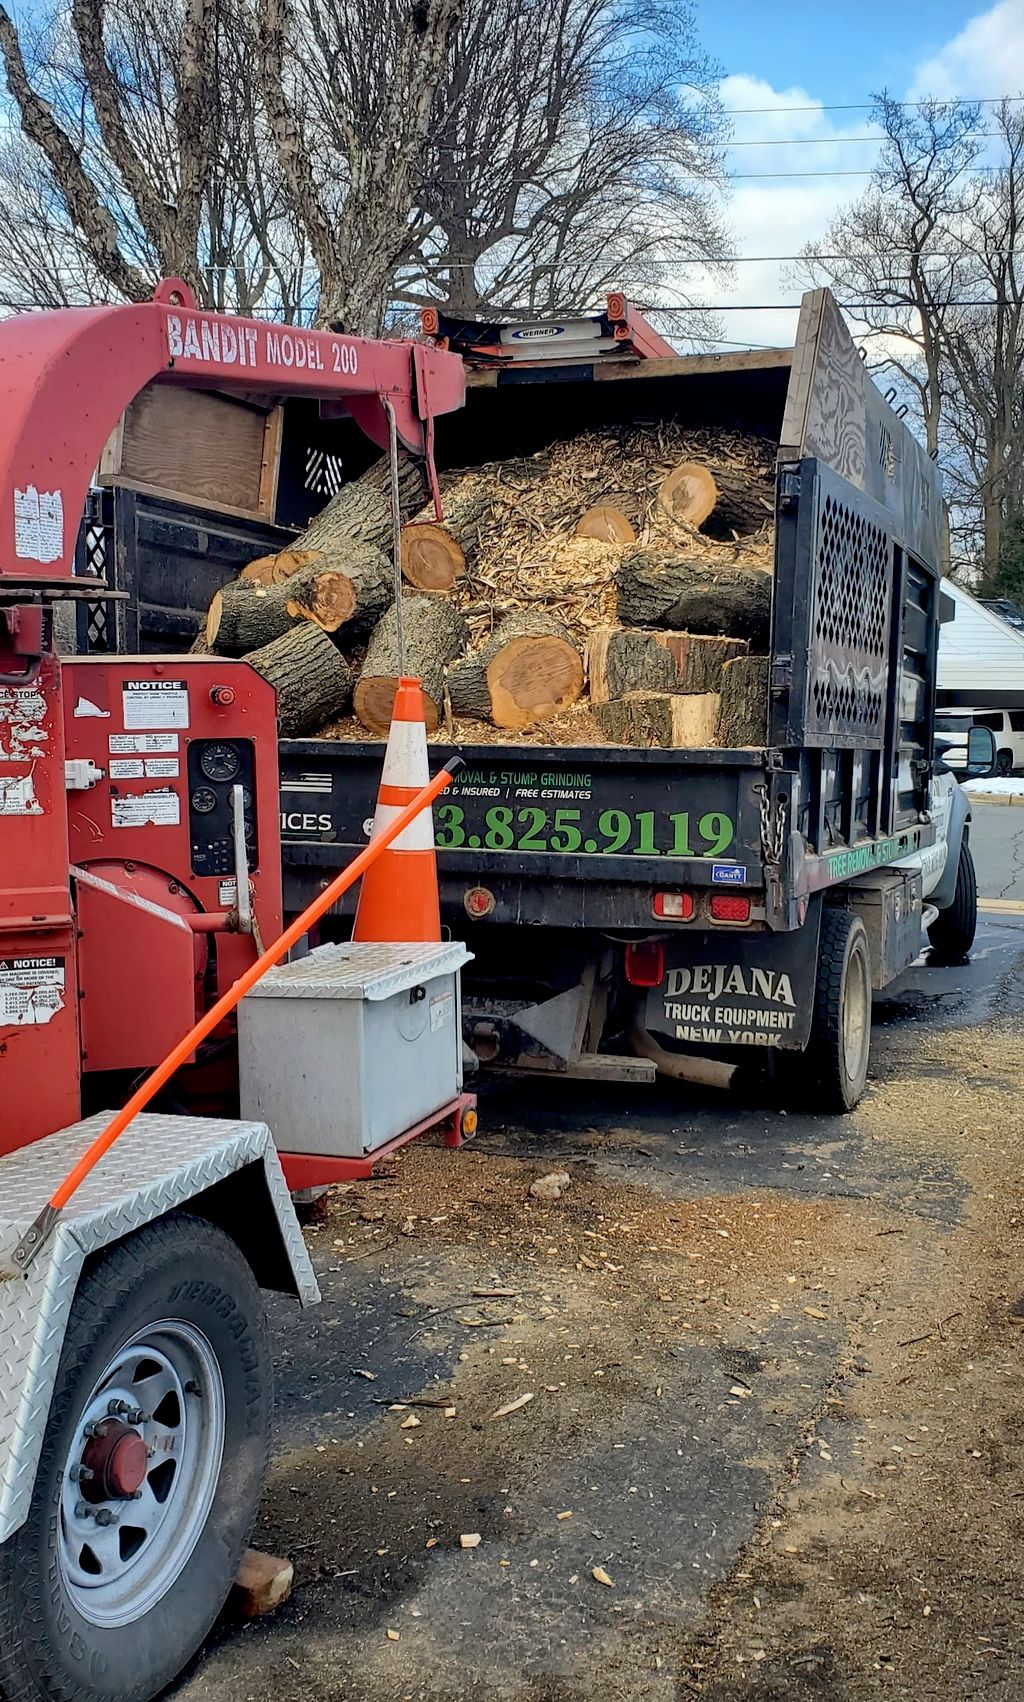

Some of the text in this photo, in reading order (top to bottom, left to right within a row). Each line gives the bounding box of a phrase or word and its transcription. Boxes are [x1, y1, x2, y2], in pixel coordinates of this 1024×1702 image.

[522, 328, 554, 337] WERNER
[167, 314, 358, 375] BANDIT MODEL 200
[128, 681, 181, 690] NOTICE
[452, 770, 592, 787] MOVAL & STUMP GRINDING
[452, 787, 460, 796] &
[461, 787, 500, 797] INSURED
[515, 788, 539, 798] FREE
[541, 789, 592, 800] ESTIMATES
[280, 813, 332, 831] ICES
[436, 805, 733, 857] 3.825.9119
[828, 854, 847, 881] TREE
[13, 958, 56, 969] NOTICE!
[663, 964, 797, 1008] DEJANA
[663, 1002, 796, 1029] TRUCK EQUIPMENT
[675, 1025, 783, 1047] NEW YORK
